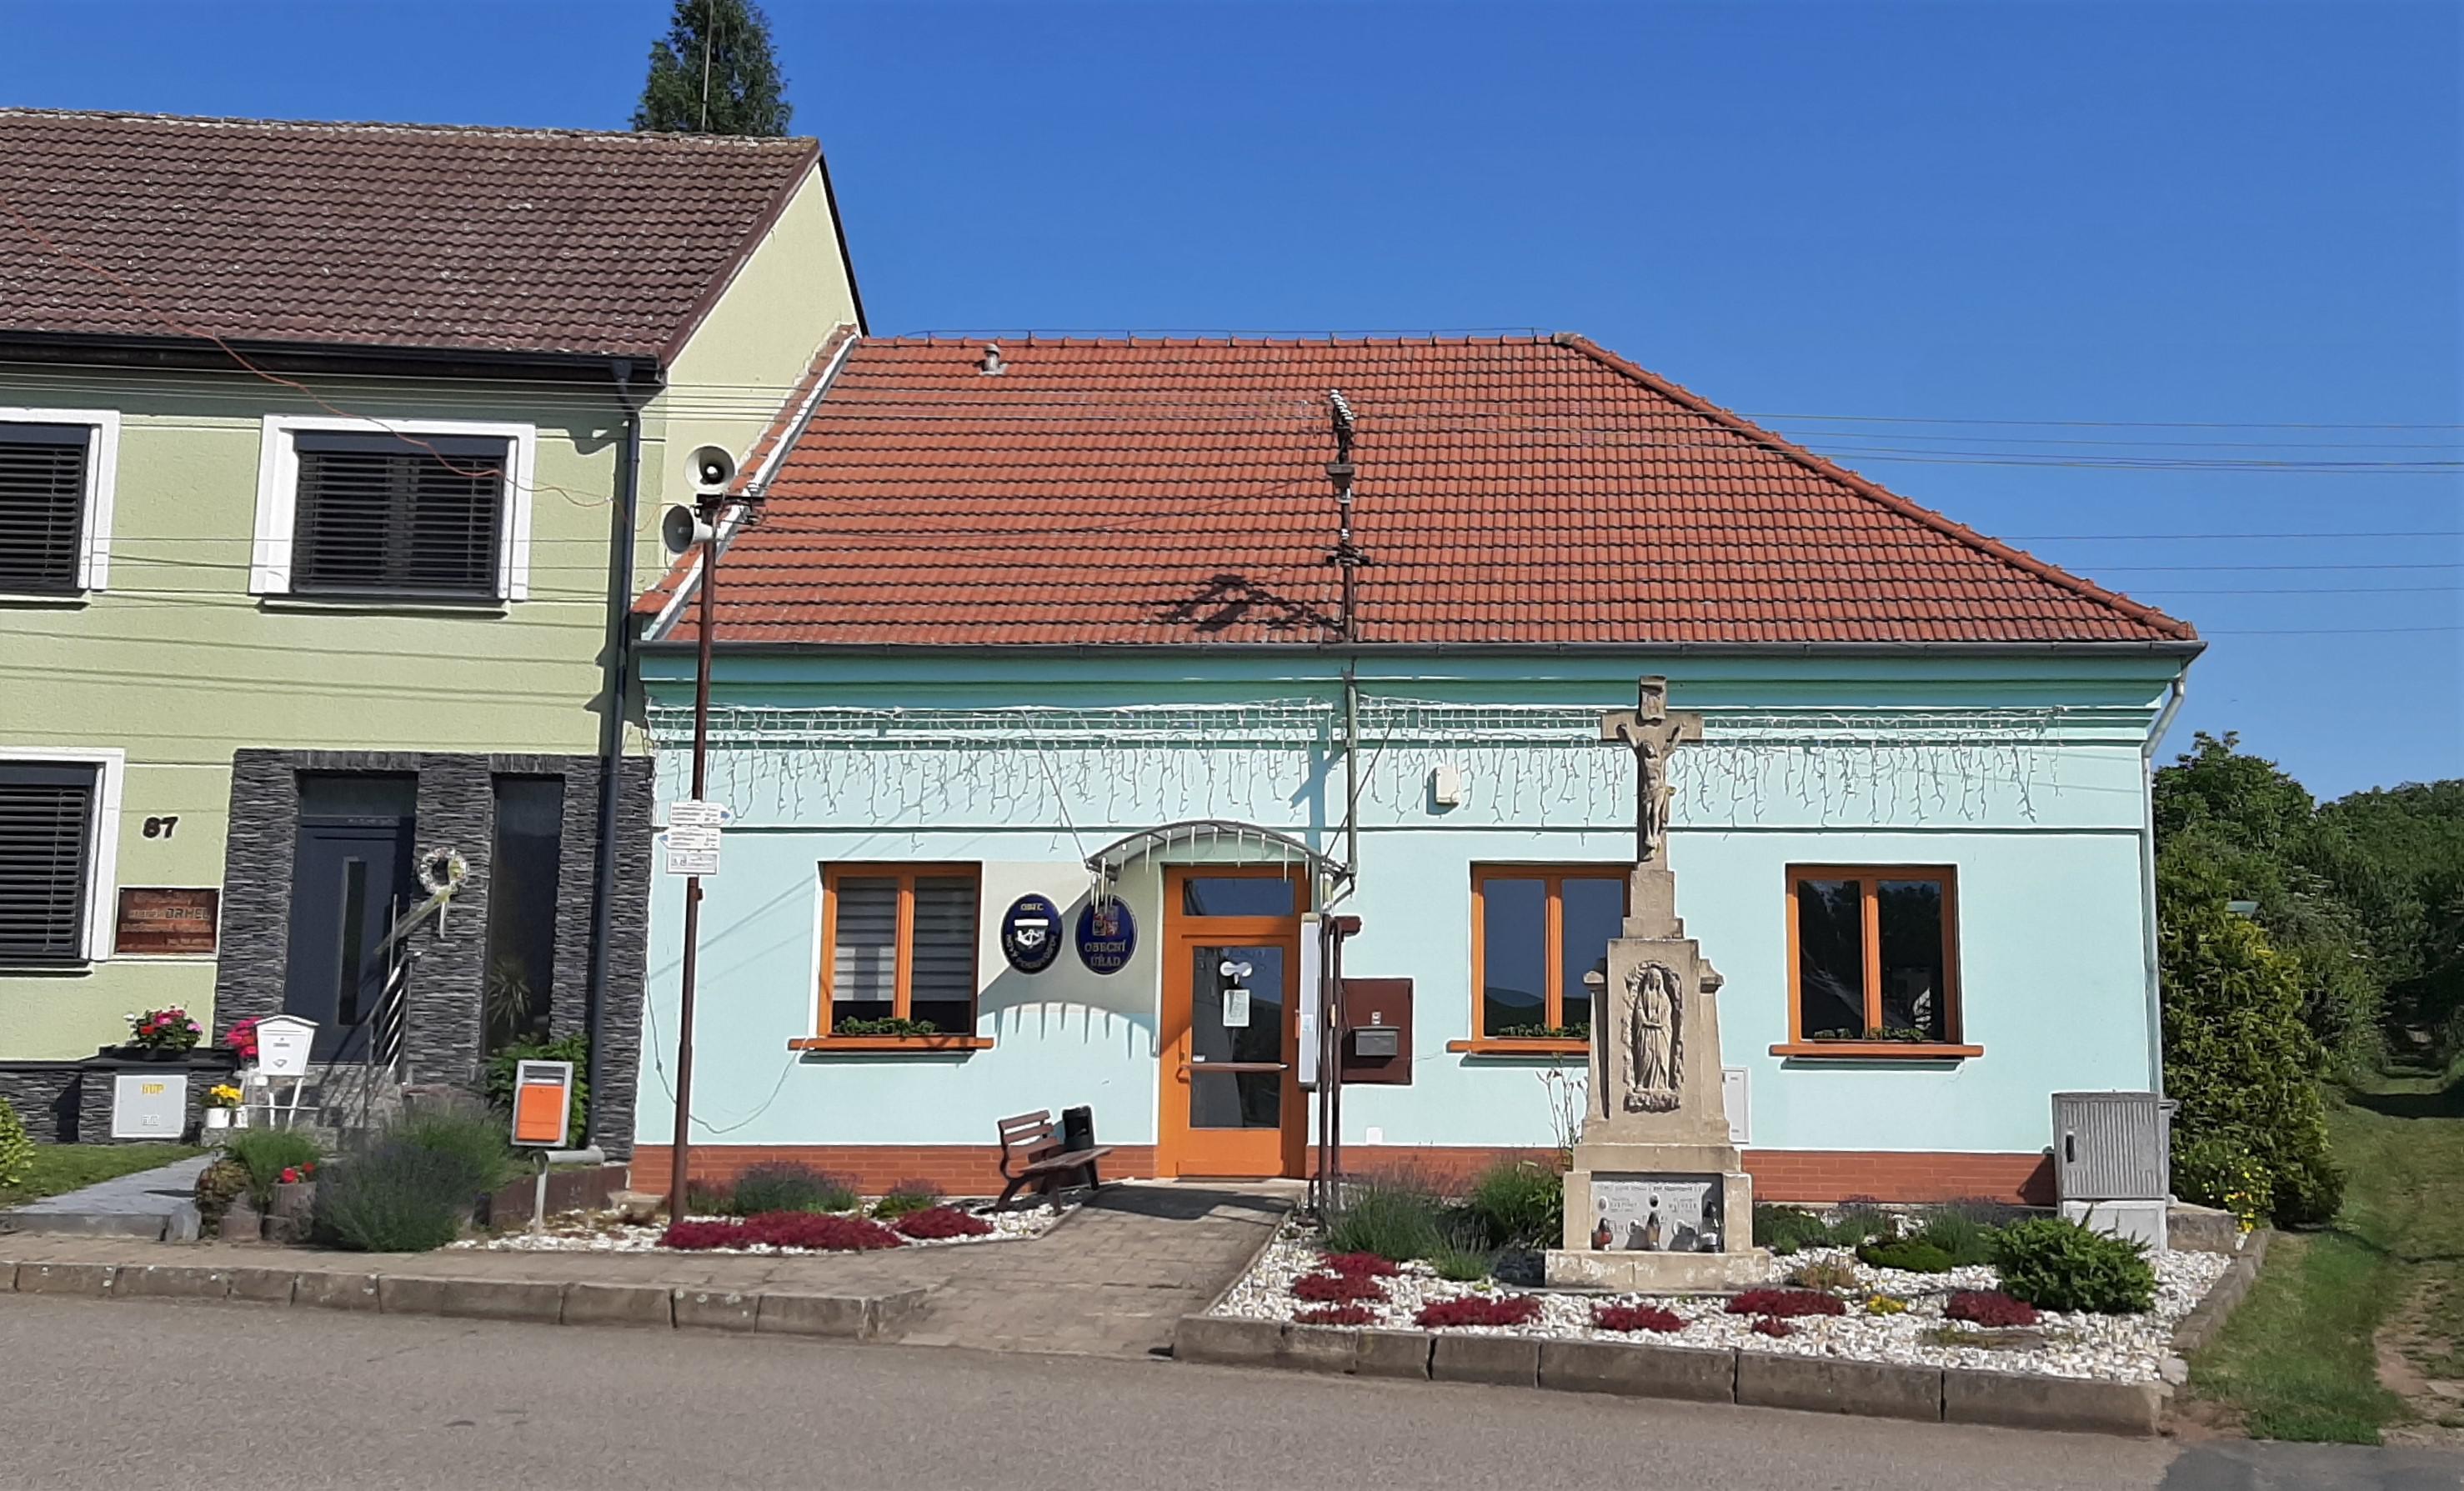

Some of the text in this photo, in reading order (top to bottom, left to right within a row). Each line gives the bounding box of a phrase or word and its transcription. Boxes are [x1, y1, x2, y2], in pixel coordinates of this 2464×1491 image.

[143, 817, 178, 838] 87
[1019, 903, 1044, 911] OBEC
[1084, 939, 1127, 953] OBECNÍ
[1090, 953, 1121, 967] ÚŘAD
